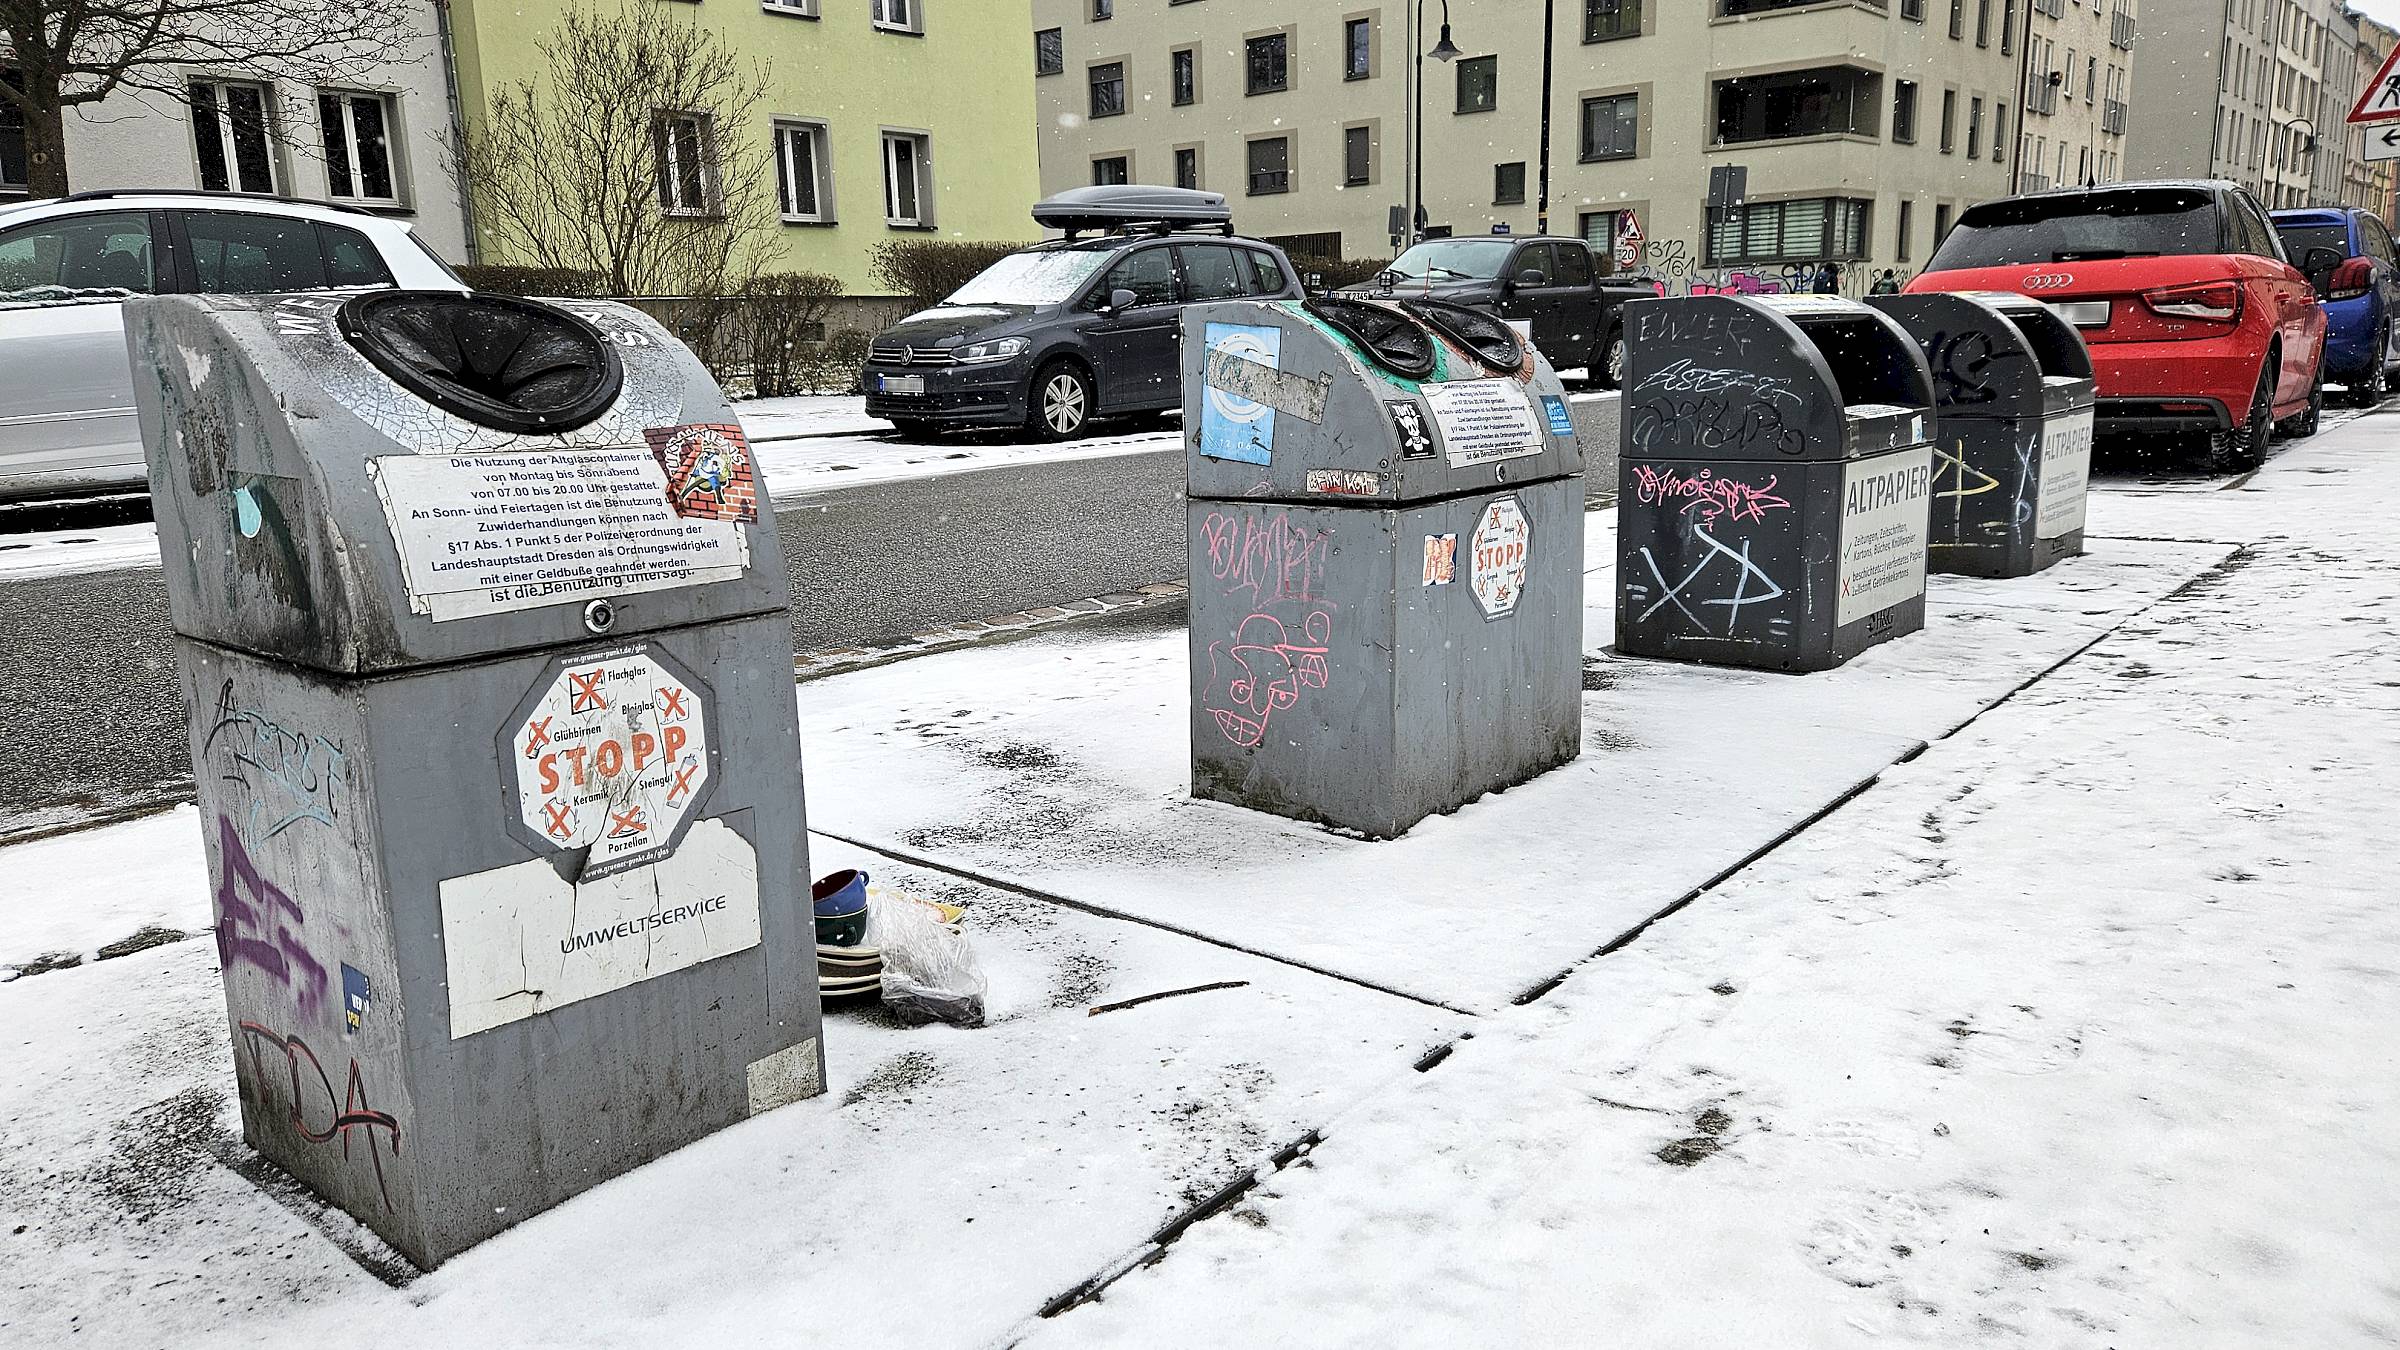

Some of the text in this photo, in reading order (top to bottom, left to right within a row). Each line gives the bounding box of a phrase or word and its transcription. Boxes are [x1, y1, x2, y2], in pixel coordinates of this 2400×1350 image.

[1621, 249, 1634, 260] 20
[2044, 426, 2091, 462] ALTPAPIER
[451, 451, 655, 468] Die Nutzung der Altglascontainer is
[483, 467, 639, 482] von Montag bis Sonnabend
[471, 481, 660, 499] von 07.00 bis 20.00 Uhr gestattet.
[1847, 465, 1928, 517] ALTPAPIER
[411, 509, 429, 520] An
[433, 507, 471, 518] Sonn-
[475, 504, 498, 516] und
[501, 502, 564, 516] Feiertagen
[568, 500, 582, 510] ist
[585, 498, 601, 509] die
[604, 496, 662, 508] Benutzung
[477, 511, 668, 533] Zuwiderhandlungen können nach
[448, 525, 702, 554] §17 Abs. 1 Punkt 5 der Polizeiverordnung der
[431, 538, 719, 572] Landeshauptstadt Dresden als Ordnungswidrigkeit
[1478, 542, 1523, 571] STOPP
[480, 558, 690, 585] mit einer Geldbuße geahndet werden.
[490, 588, 510, 602] ist
[515, 584, 538, 599] die
[543, 575, 622, 596] Benutzung
[561, 643, 647, 665] www.gruener-punkt.de/glas
[608, 666, 646, 681] Flachglas
[554, 725, 602, 742] Glühbirnen
[538, 726, 687, 794] STOPP
[639, 774, 673, 790] Steingut
[573, 789, 609, 807] Keramik
[608, 836, 648, 853] Porzellan
[585, 848, 669, 878] www.gruener-punkt.de/glas
[560, 895, 726, 954] UMWELTSERVICE
